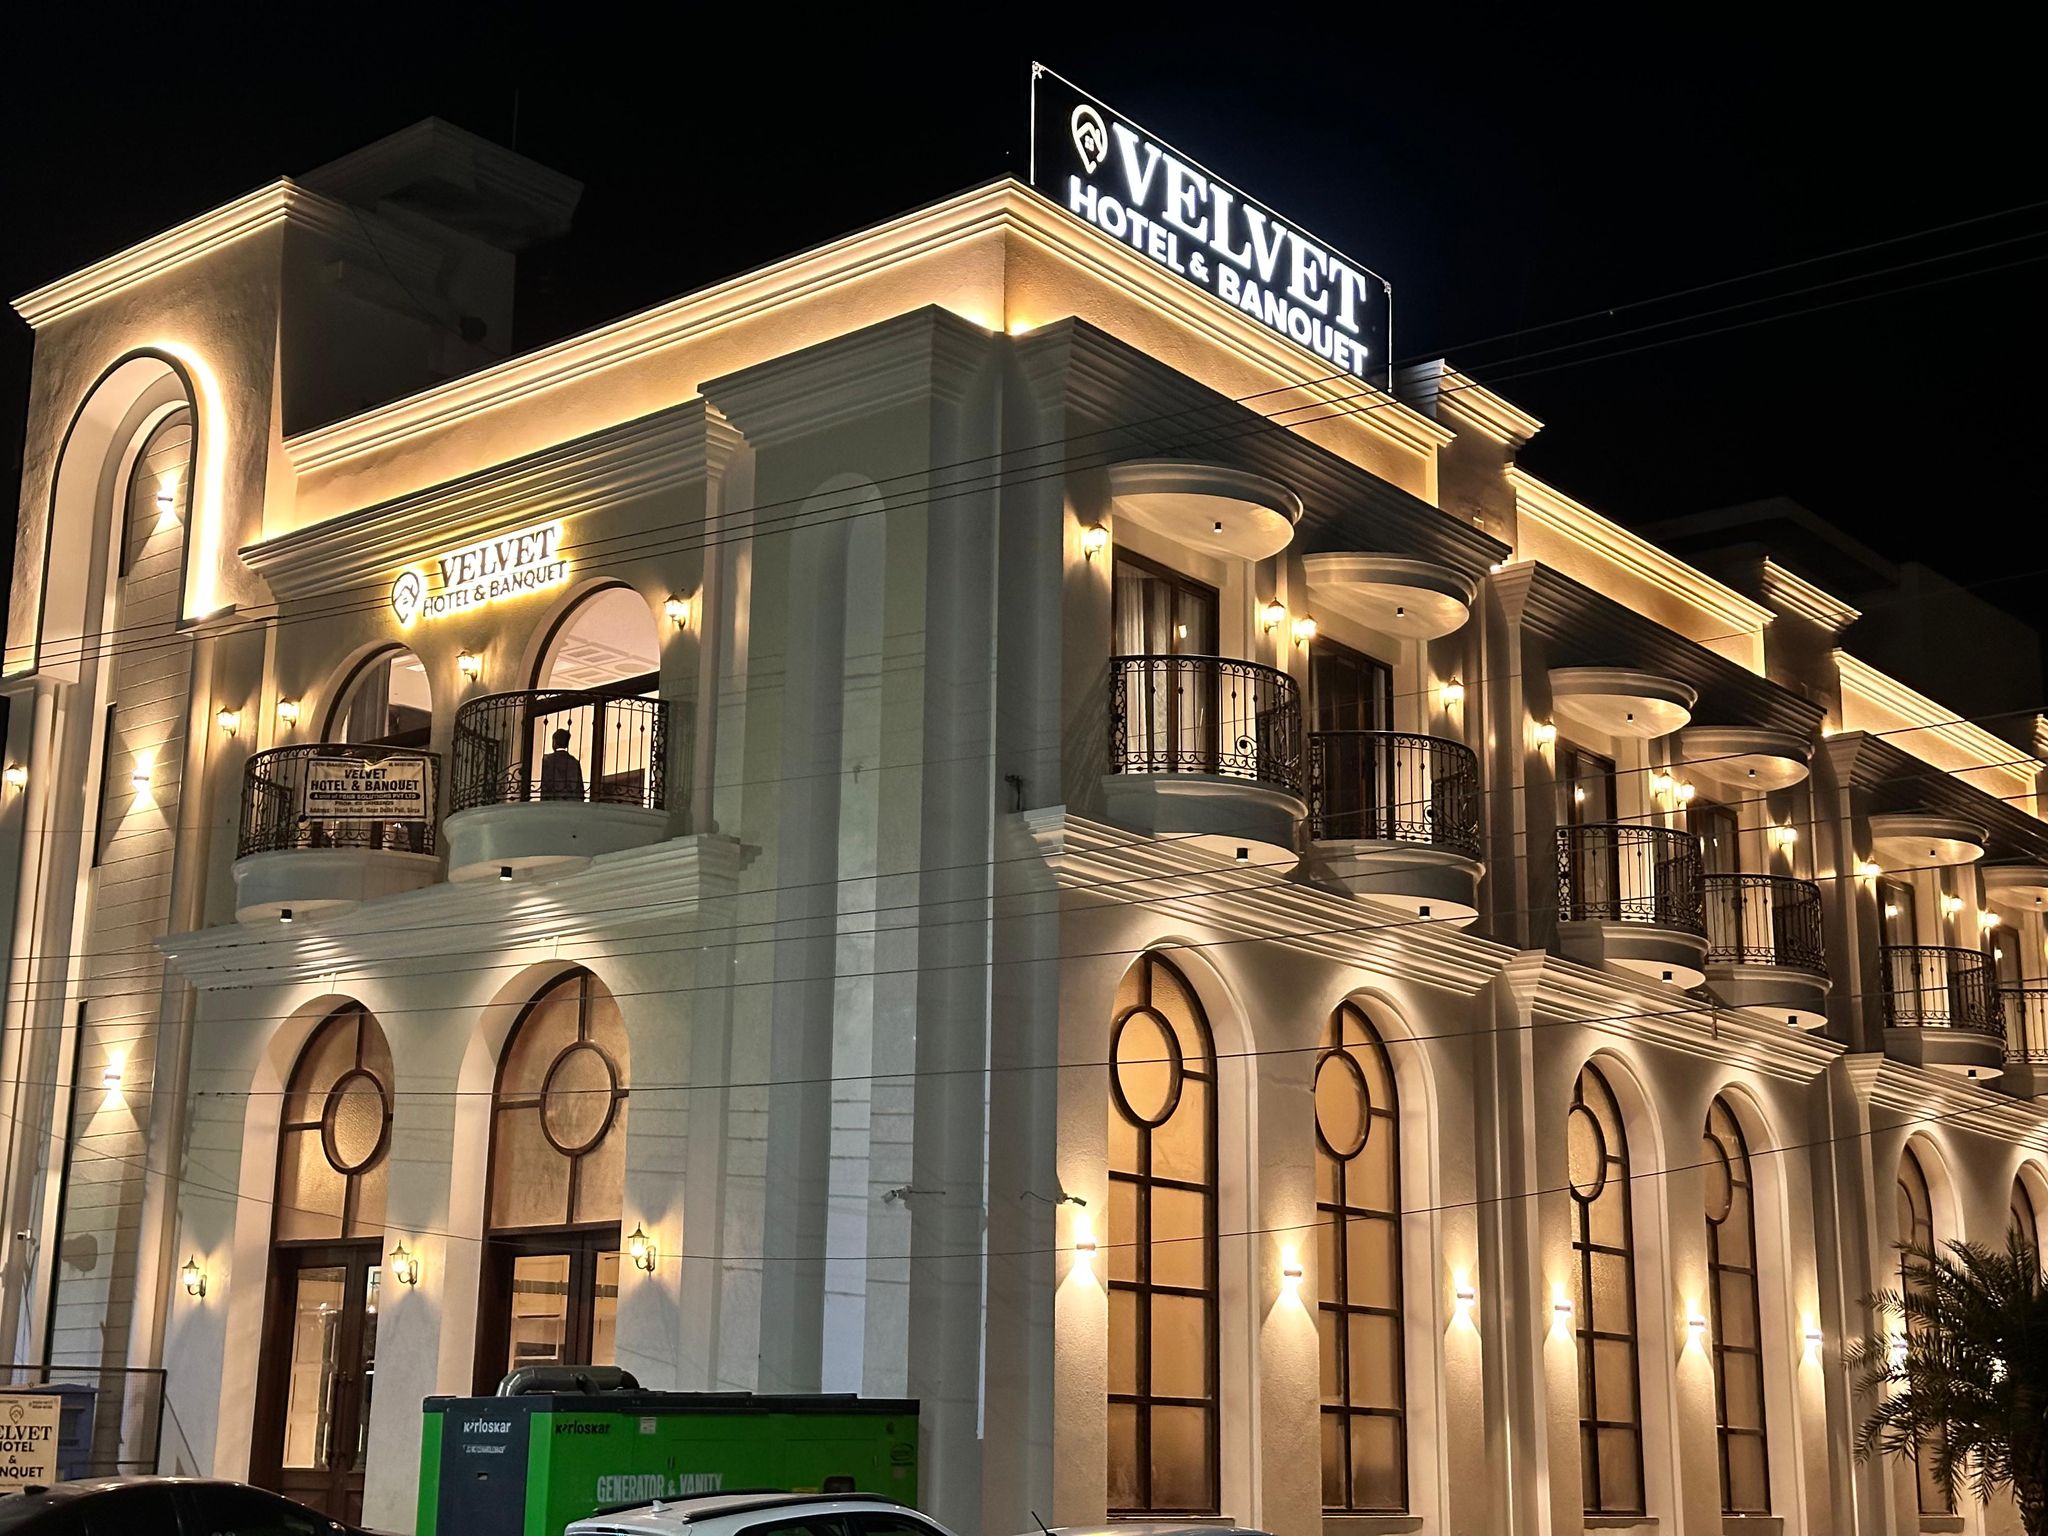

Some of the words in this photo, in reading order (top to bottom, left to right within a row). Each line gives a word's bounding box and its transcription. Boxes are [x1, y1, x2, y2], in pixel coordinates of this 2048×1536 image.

[1069, 174, 1185, 274] HOTEL
[1189, 252, 1210, 283] &
[1112, 121, 1367, 334] VELVET
[438, 526, 555, 588] VELVET
[423, 589, 469, 617] HOTEL
[474, 584, 486, 601] &
[490, 560, 567, 598] BANQUET
[310, 780, 347, 791] HOTEL
[351, 780, 360, 791] &
[365, 780, 419, 791] BANQUET
[344, 768, 387, 779] VELVET
[0, 1441, 35, 1453] OTEL
[8, 1454, 17, 1464] &
[597, 1474, 664, 1502] GENERATOR
[668, 1480, 675, 1496] &
[680, 1473, 723, 1495] VANITY
